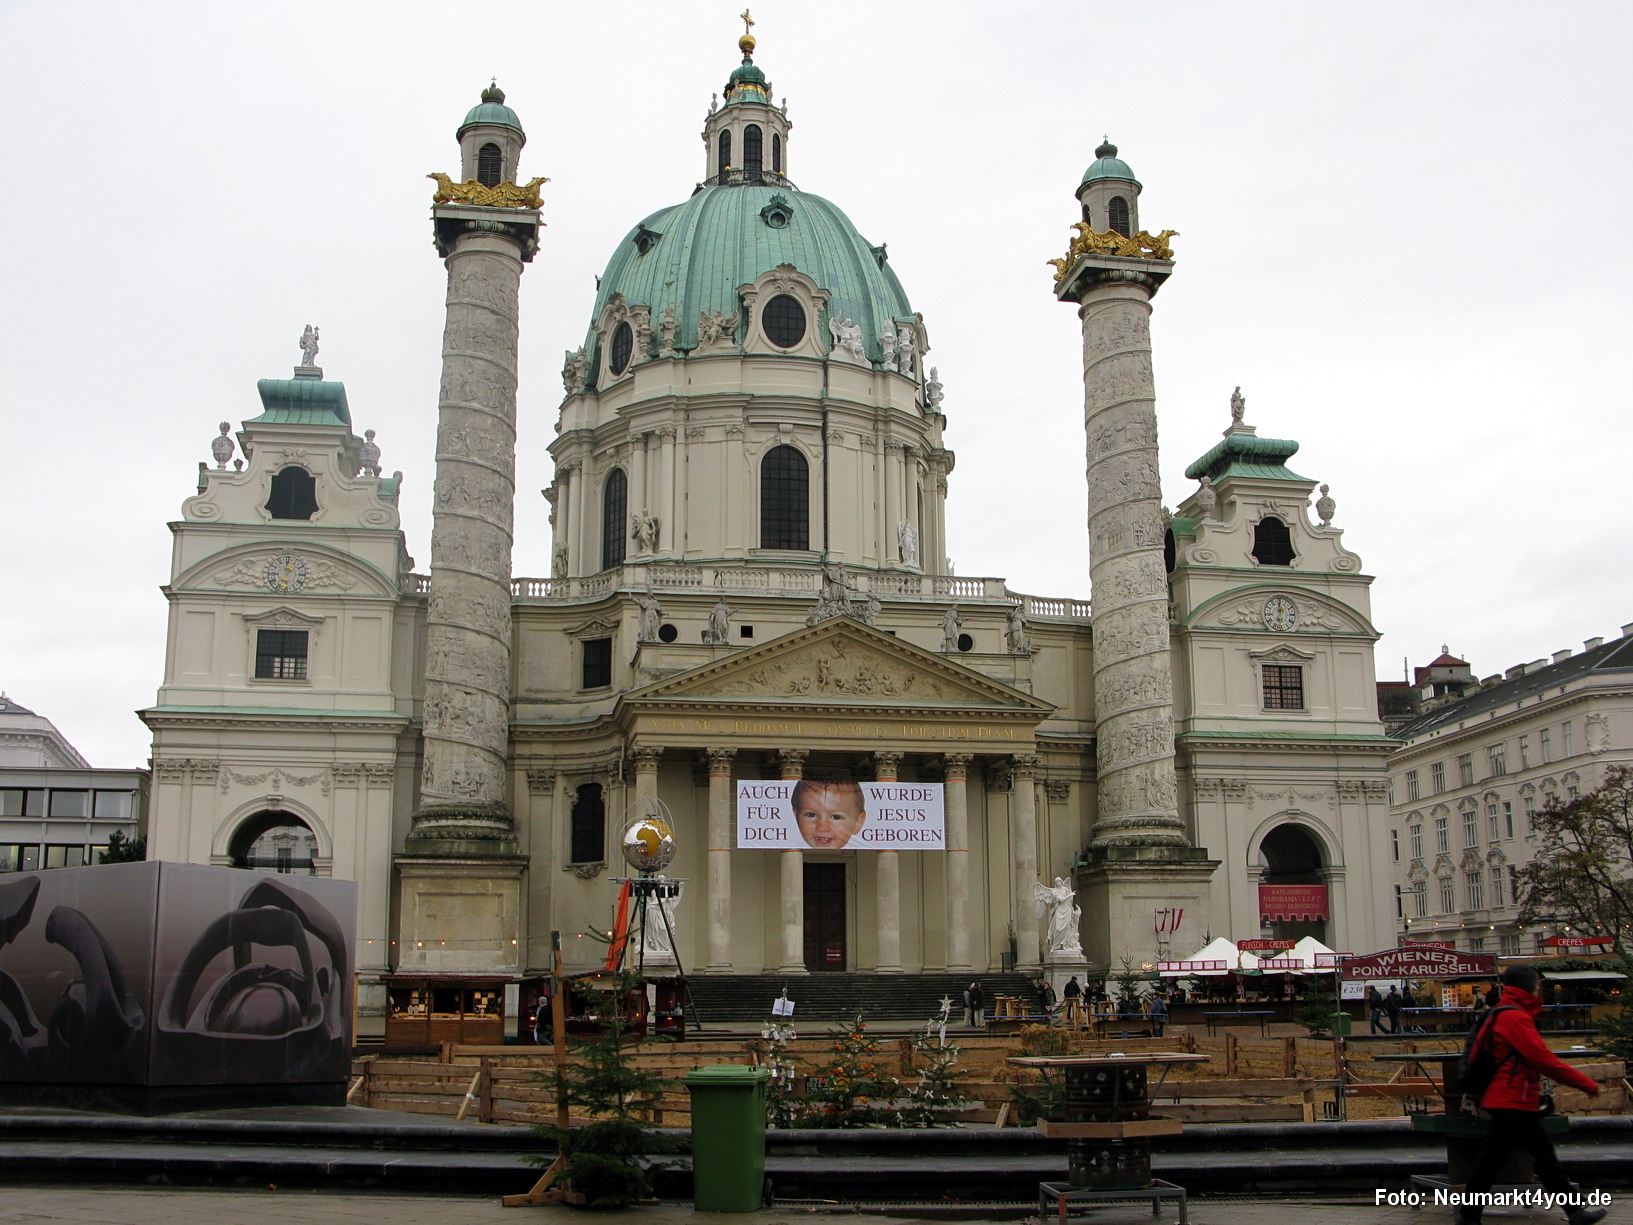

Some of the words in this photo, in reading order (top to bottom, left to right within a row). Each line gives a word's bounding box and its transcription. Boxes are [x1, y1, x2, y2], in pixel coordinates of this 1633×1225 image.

[739, 786, 789, 799] AUCH
[870, 788, 934, 801] WURDE
[747, 804, 781, 819] FÜR
[877, 809, 926, 821] JESUS
[744, 828, 787, 840] DICH
[861, 829, 943, 841] GEBOREN
[1241, 941, 1264, 949] PUNSCH
[1377, 952, 1458, 965] WIENER
[1353, 964, 1483, 976] PONY-KARUSSELL
